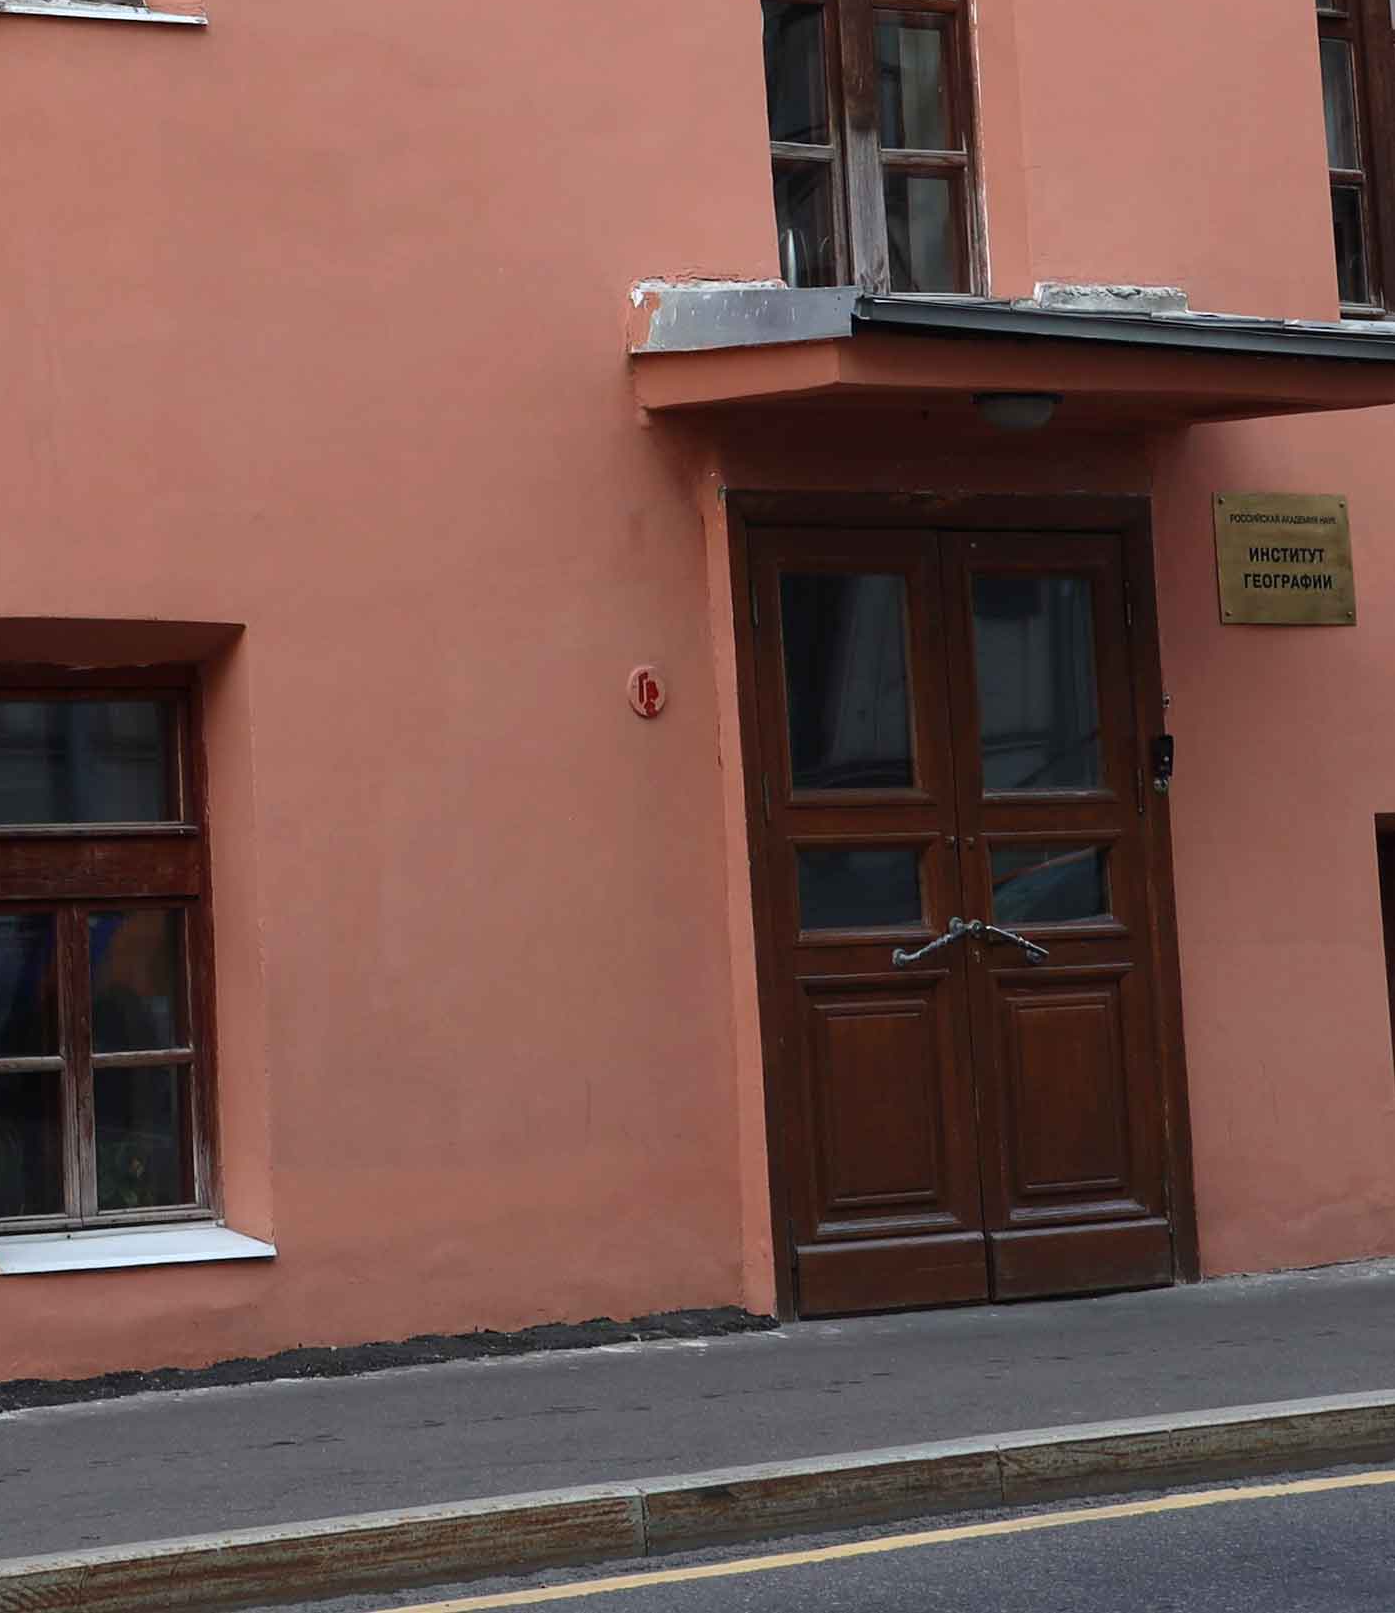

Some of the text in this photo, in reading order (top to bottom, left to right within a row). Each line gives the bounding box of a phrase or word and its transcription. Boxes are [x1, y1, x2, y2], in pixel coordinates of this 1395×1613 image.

[1230, 513, 1281, 525] РОССИЙСКАЯ
[1249, 547, 1324, 563] ИНСТИТУТ
[1243, 573, 1333, 589] ГЕОГРАФИИ
